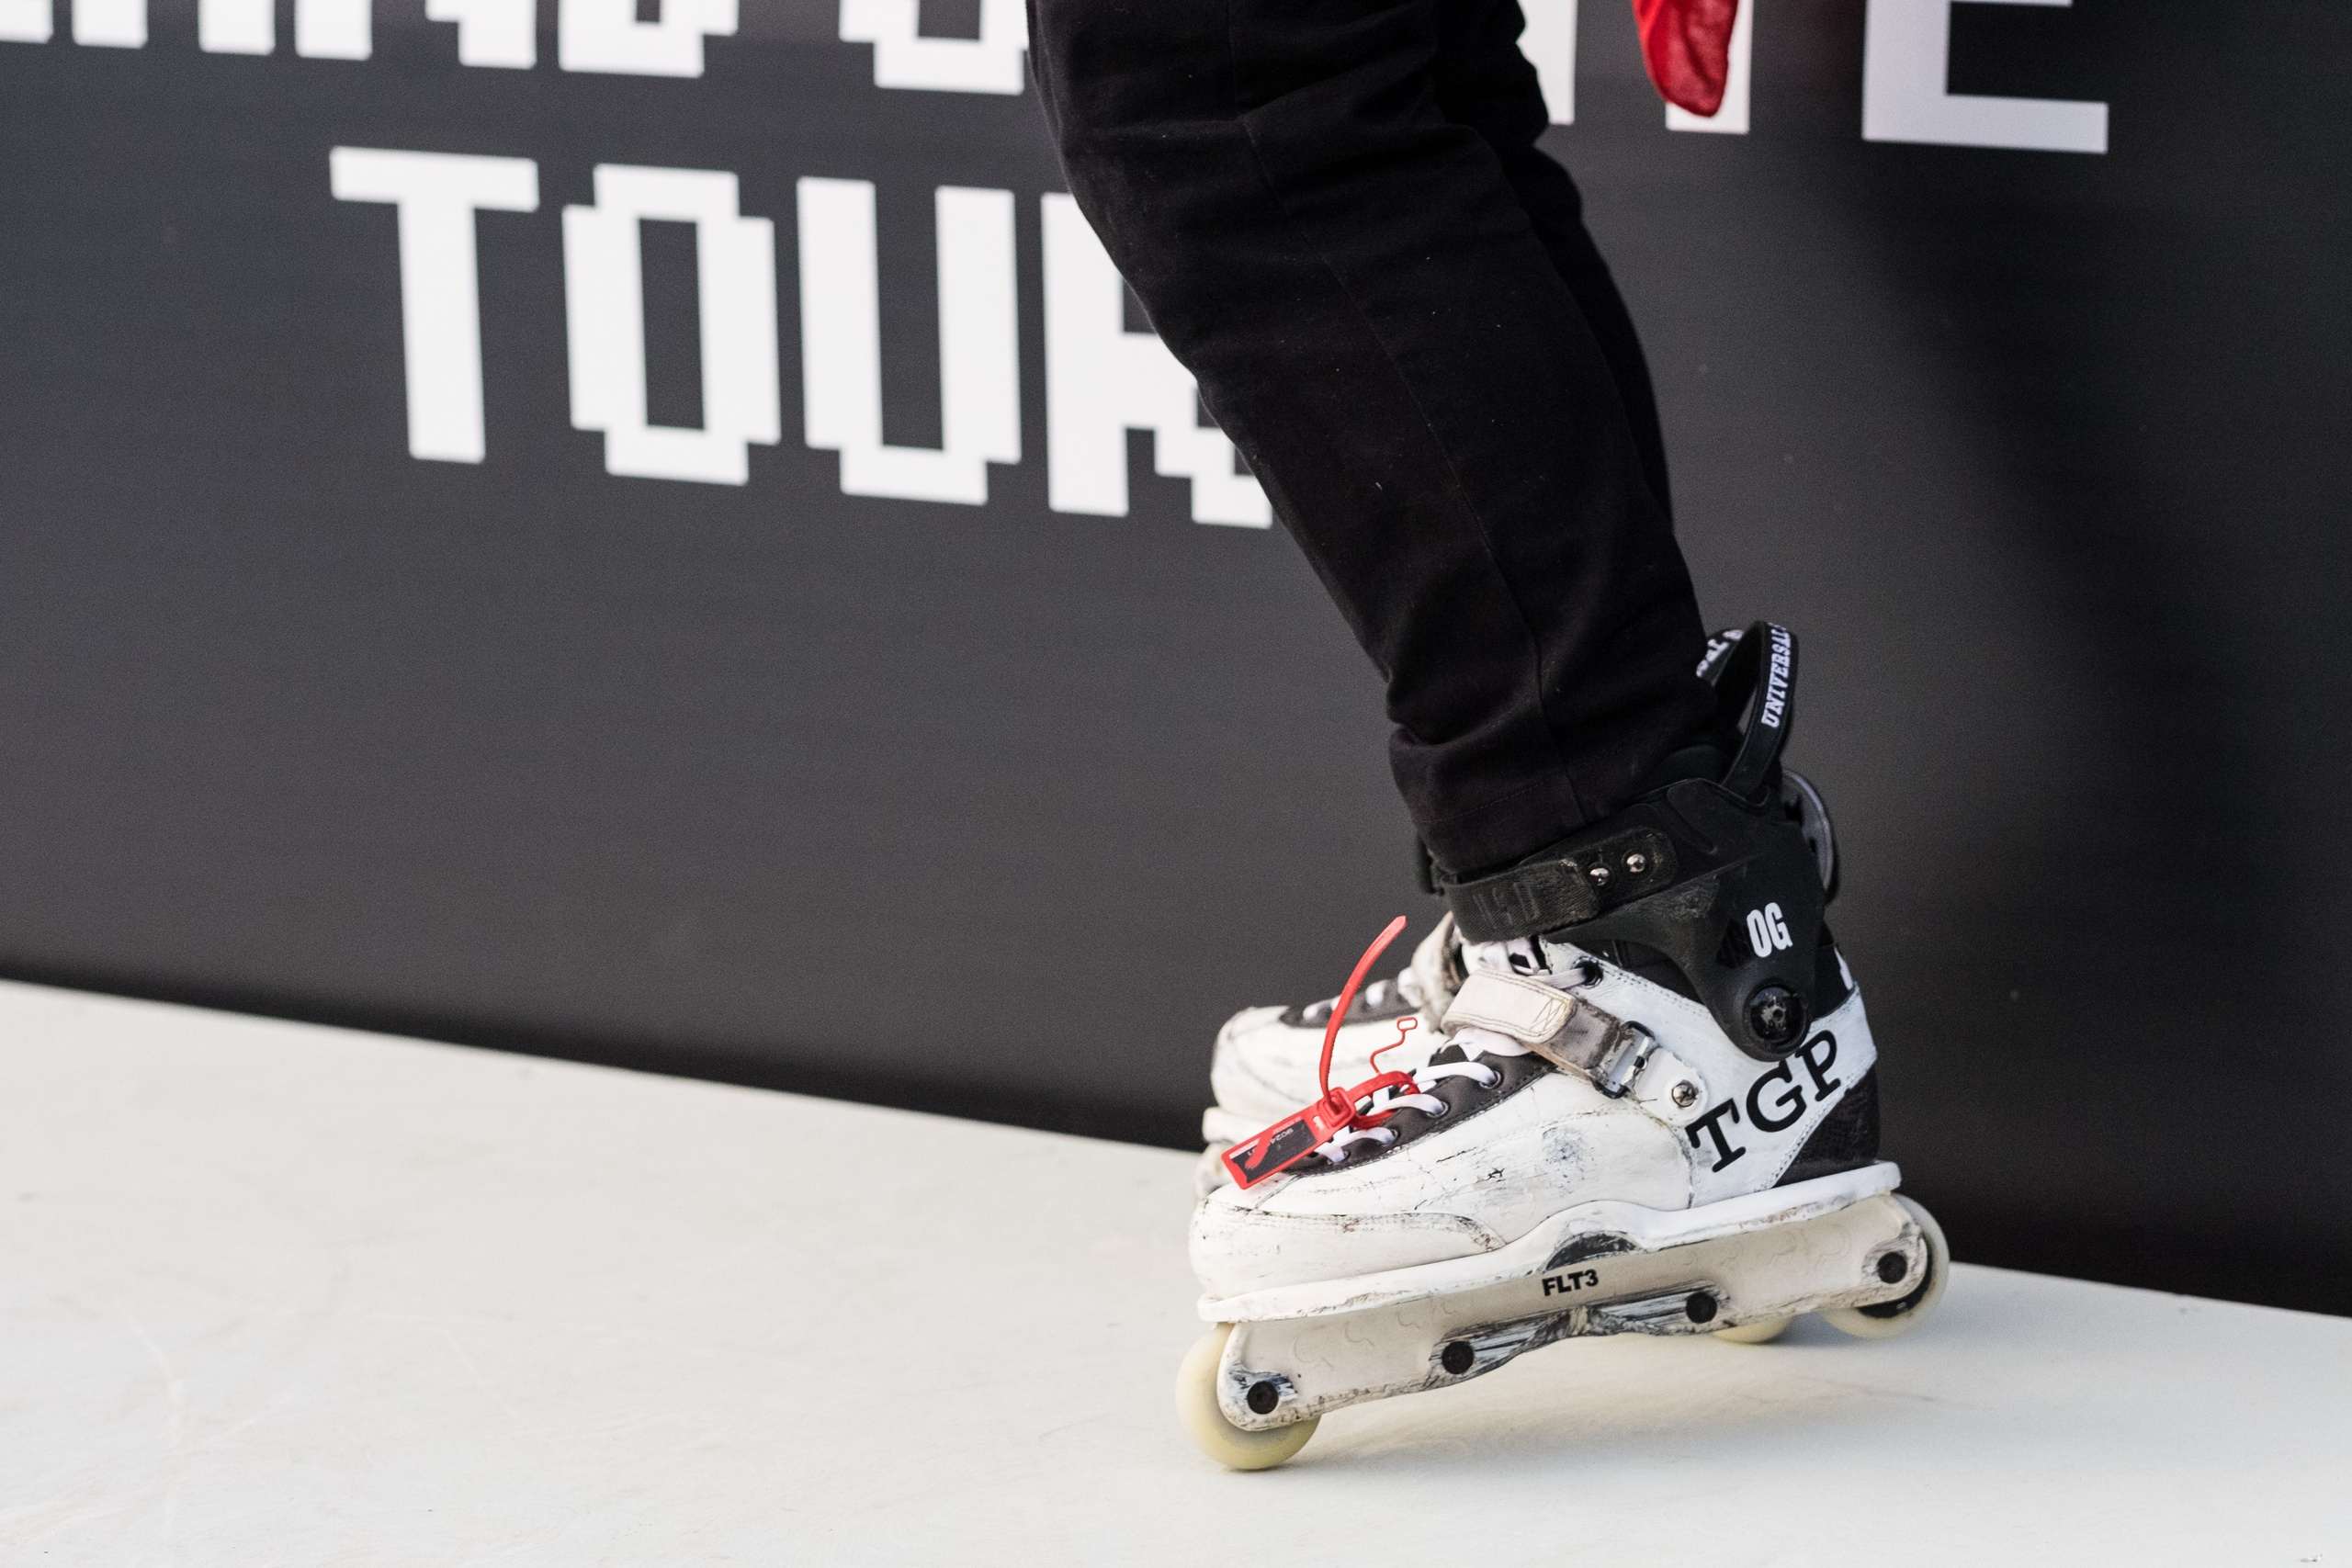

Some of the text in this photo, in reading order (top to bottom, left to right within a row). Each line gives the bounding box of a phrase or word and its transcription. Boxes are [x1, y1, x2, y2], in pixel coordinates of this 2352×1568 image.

[1746, 901, 1793, 958] OG
[1684, 1029, 1841, 1173] TGP
[1542, 1269, 1599, 1297] FLT3
